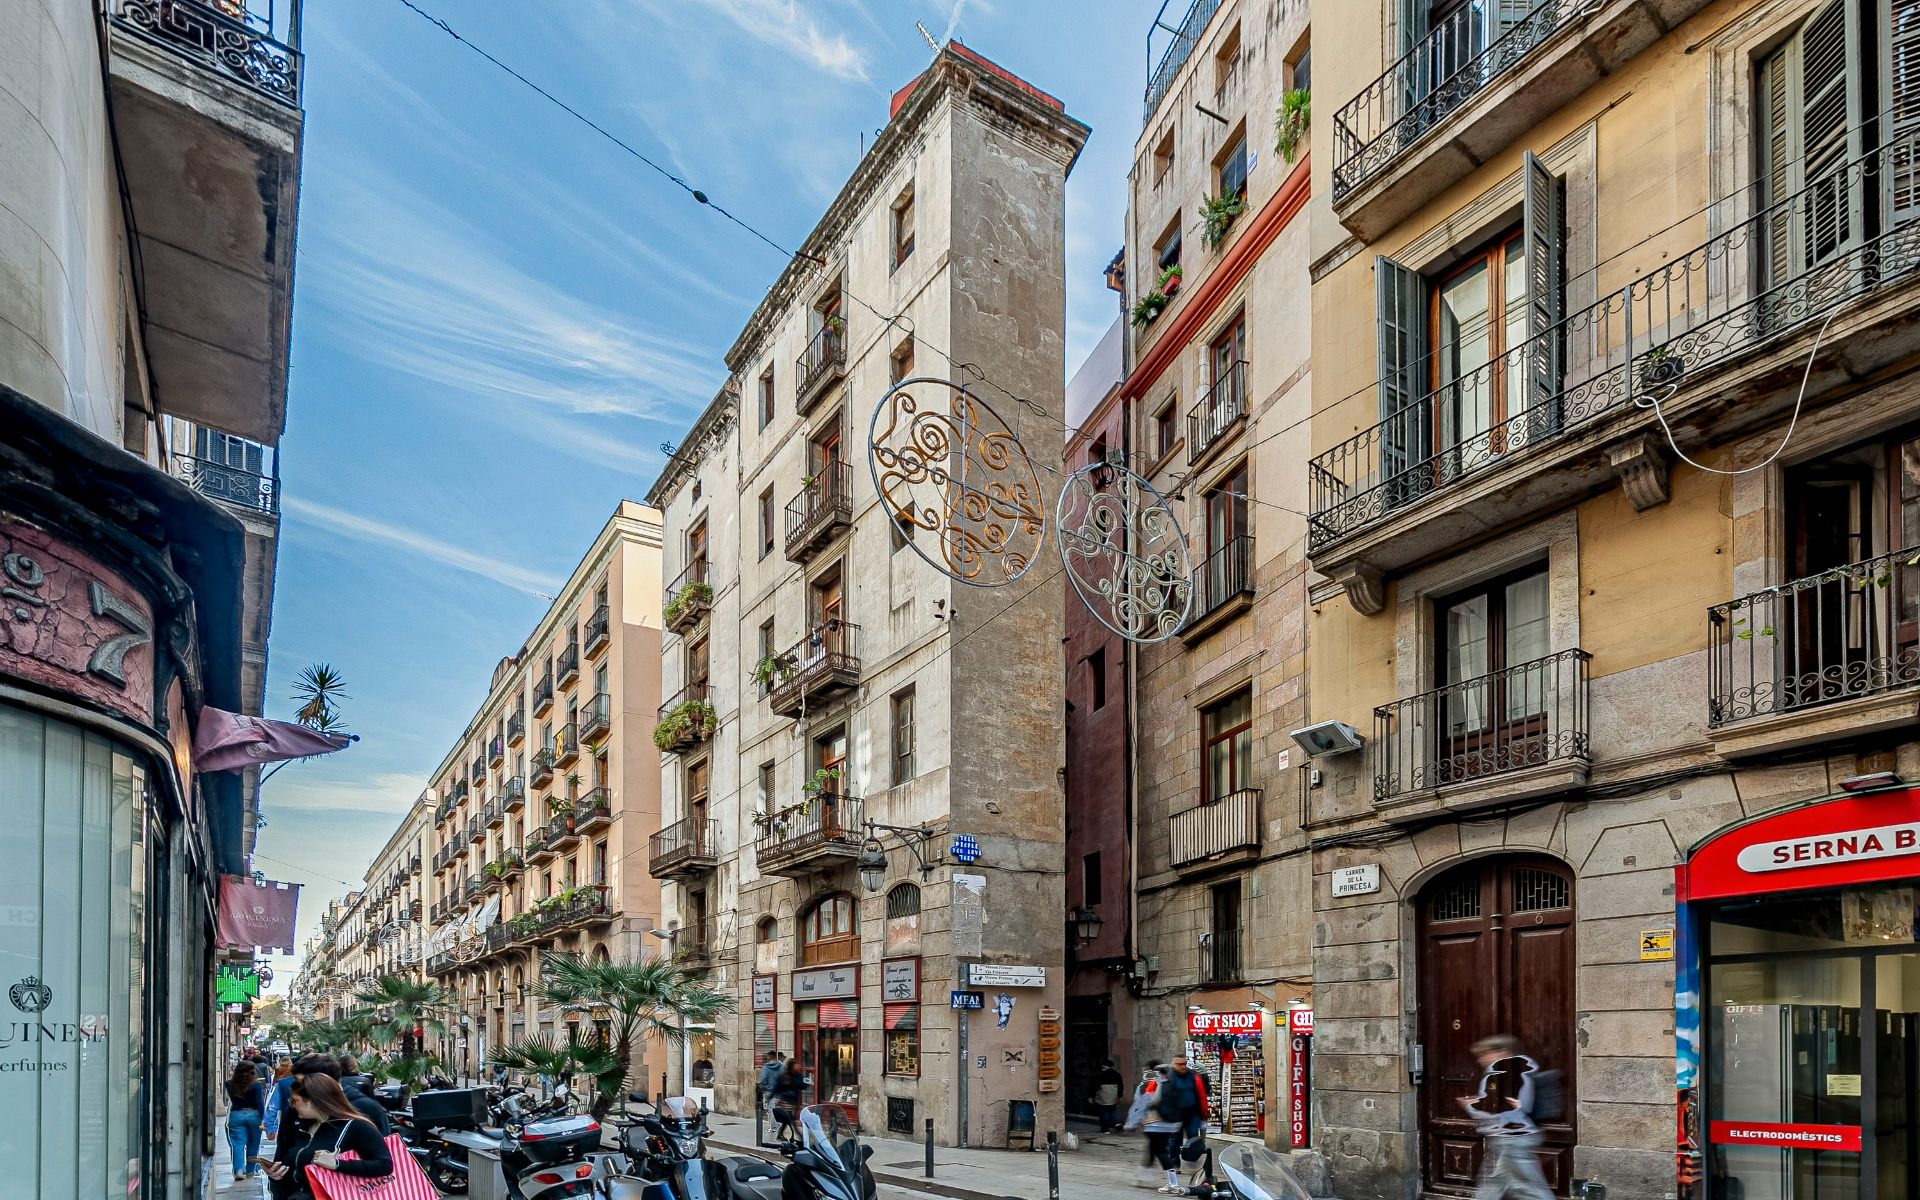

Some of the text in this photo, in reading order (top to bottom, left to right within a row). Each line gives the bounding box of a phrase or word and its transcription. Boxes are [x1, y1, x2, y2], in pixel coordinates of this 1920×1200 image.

[87, 580, 152, 688] 7
[1773, 829, 1920, 864] SERNA B
[1339, 882, 1372, 892] PRINCESA
[1535, 912, 1544, 924] 6
[1193, 1013, 1257, 1029] GIFT SHOP
[0, 1058, 68, 1072] erfumes
[1292, 1038, 1304, 1096] GIFT
[1293, 1099, 1304, 1144] SHOP
[1729, 1130, 1843, 1143] ELECTRODOMÈSTICS
